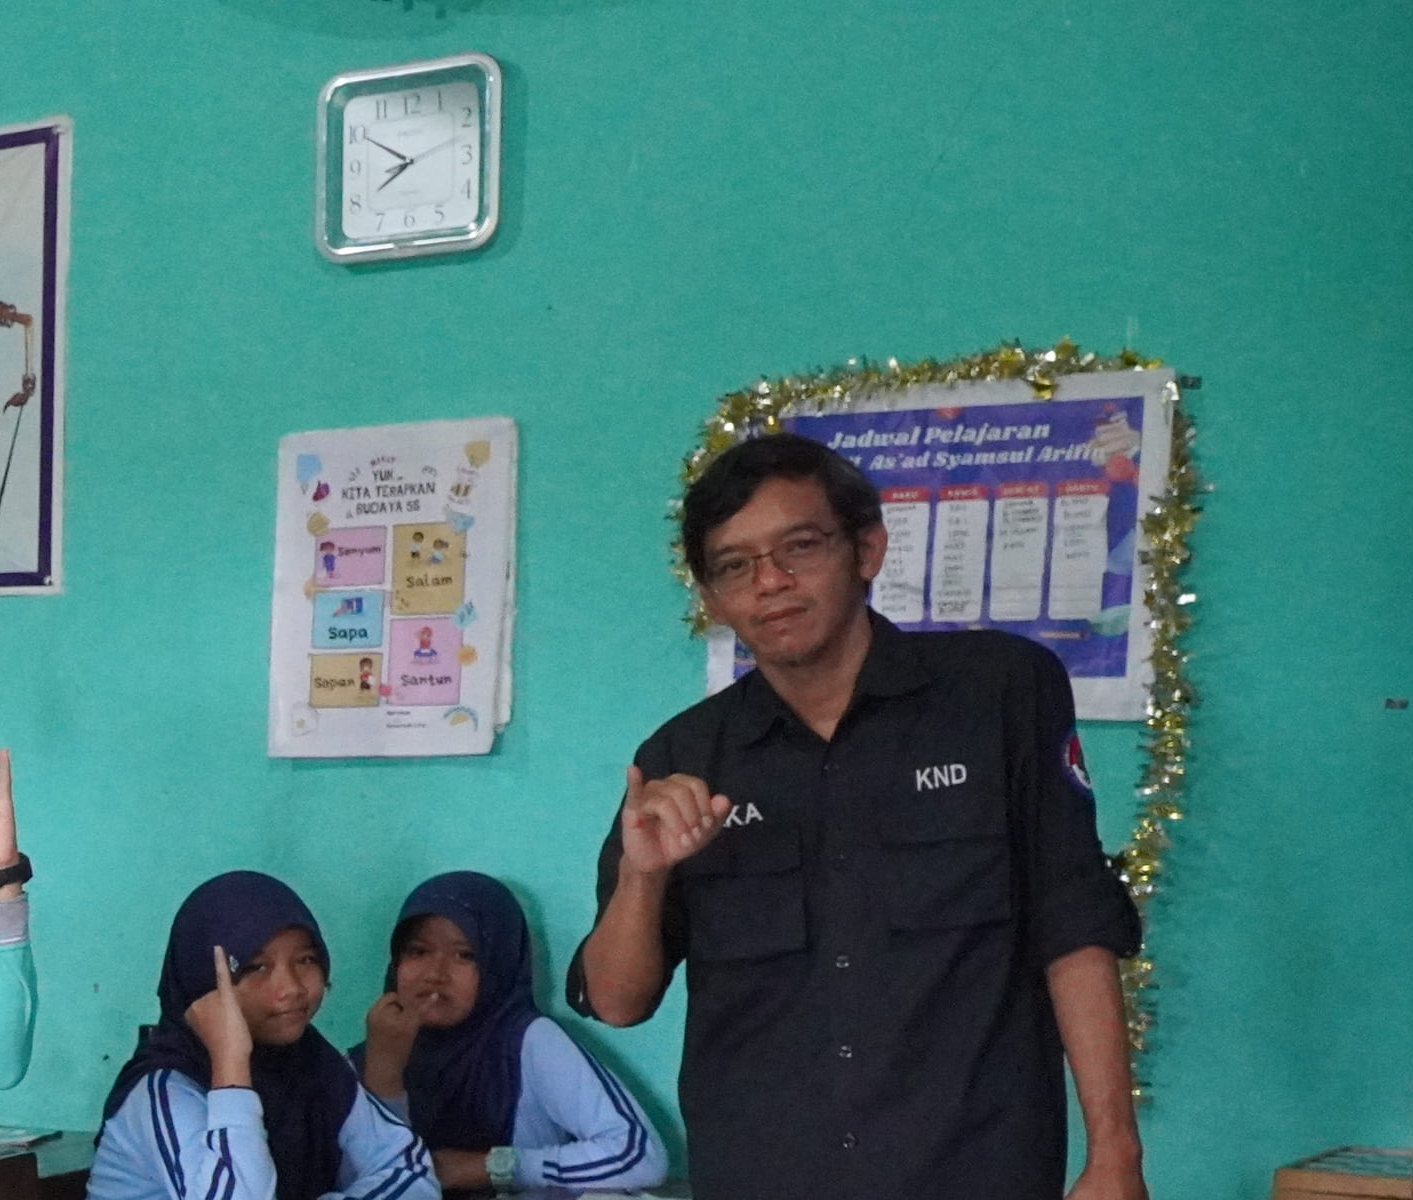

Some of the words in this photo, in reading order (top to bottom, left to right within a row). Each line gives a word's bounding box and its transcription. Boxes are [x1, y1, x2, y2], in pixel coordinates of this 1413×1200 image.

[404, 92, 421, 116] 12
[827, 425, 921, 450] Jadwal
[923, 421, 1051, 446] Pelajaran
[933, 446, 1034, 470] Syamsul
[341, 486, 371, 501] KITA
[375, 481, 436, 498] TERAPKAN
[355, 500, 403, 516] BUDAYA
[405, 573, 454, 589] Salam
[327, 626, 369, 643] Sapa
[400, 673, 452, 687] Santun
[915, 762, 968, 792] KND
